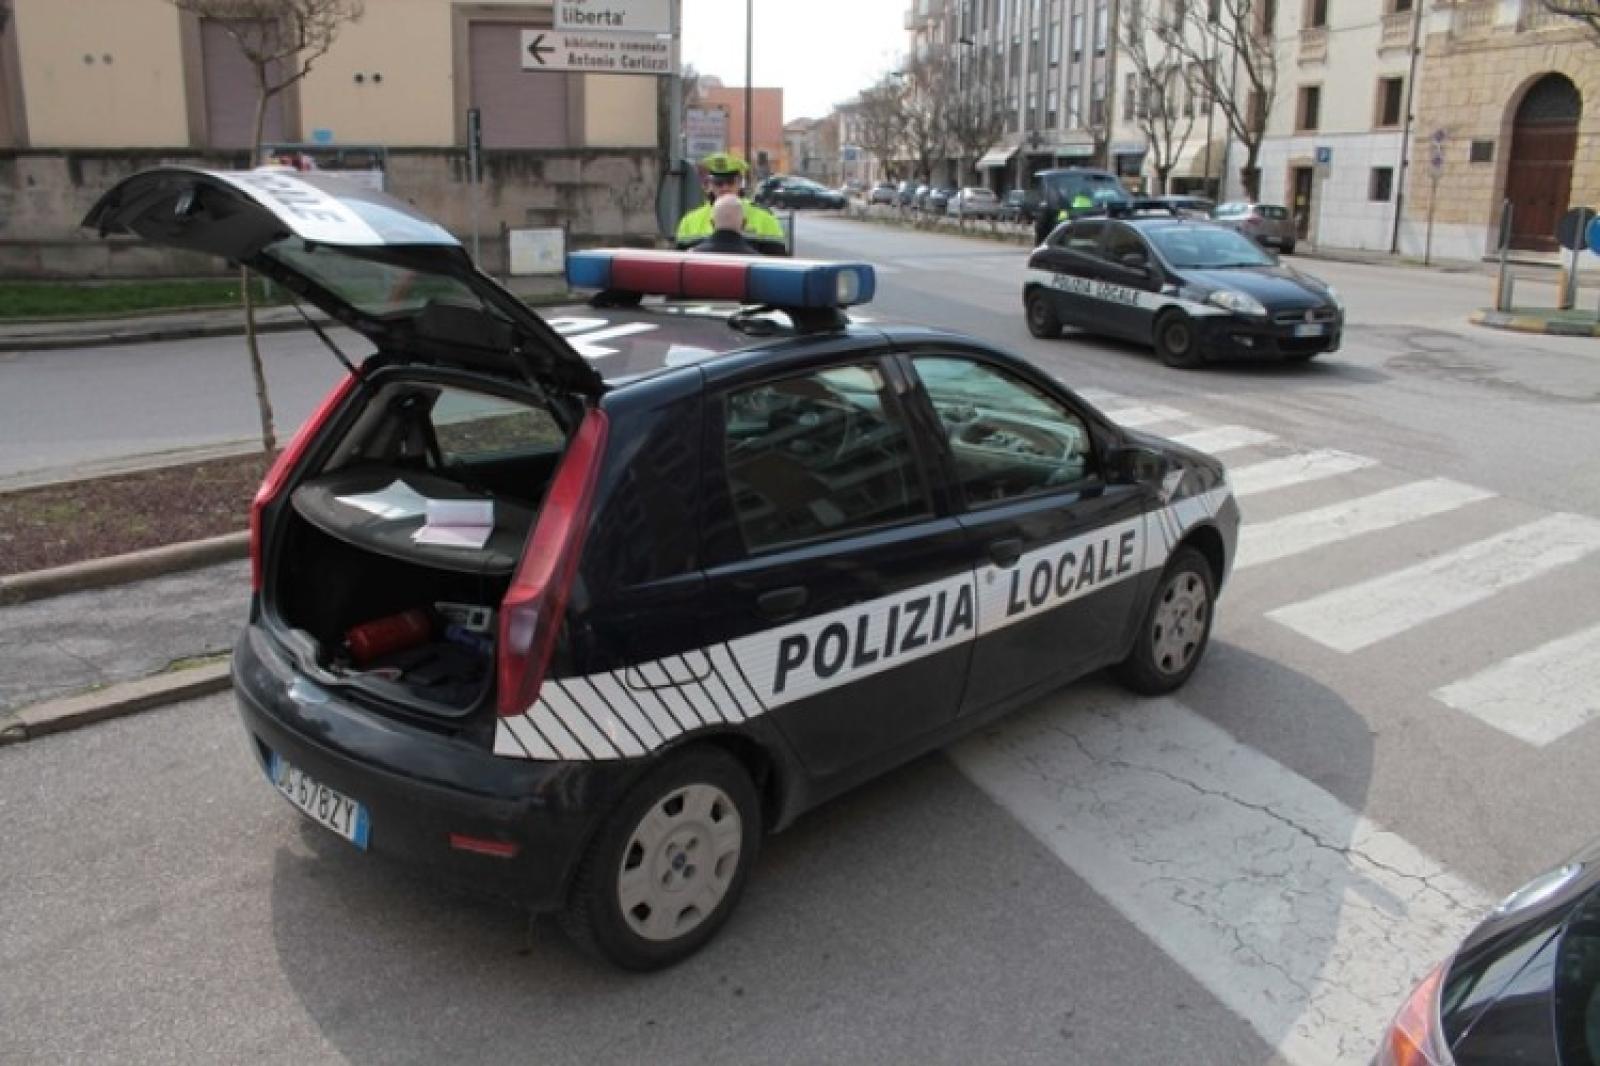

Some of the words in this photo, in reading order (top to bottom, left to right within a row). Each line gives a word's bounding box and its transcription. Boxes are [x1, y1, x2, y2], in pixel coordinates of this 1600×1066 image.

[564, 36, 615, 49] biblioteca
[620, 39, 667, 52] comunale
[567, 51, 615, 67] Antonio
[1053, 272, 1091, 296] POLIZIA
[1096, 282, 1138, 305] LOCALE
[772, 584, 975, 694] POLIZIA
[1006, 529, 1136, 617] LOCALE
